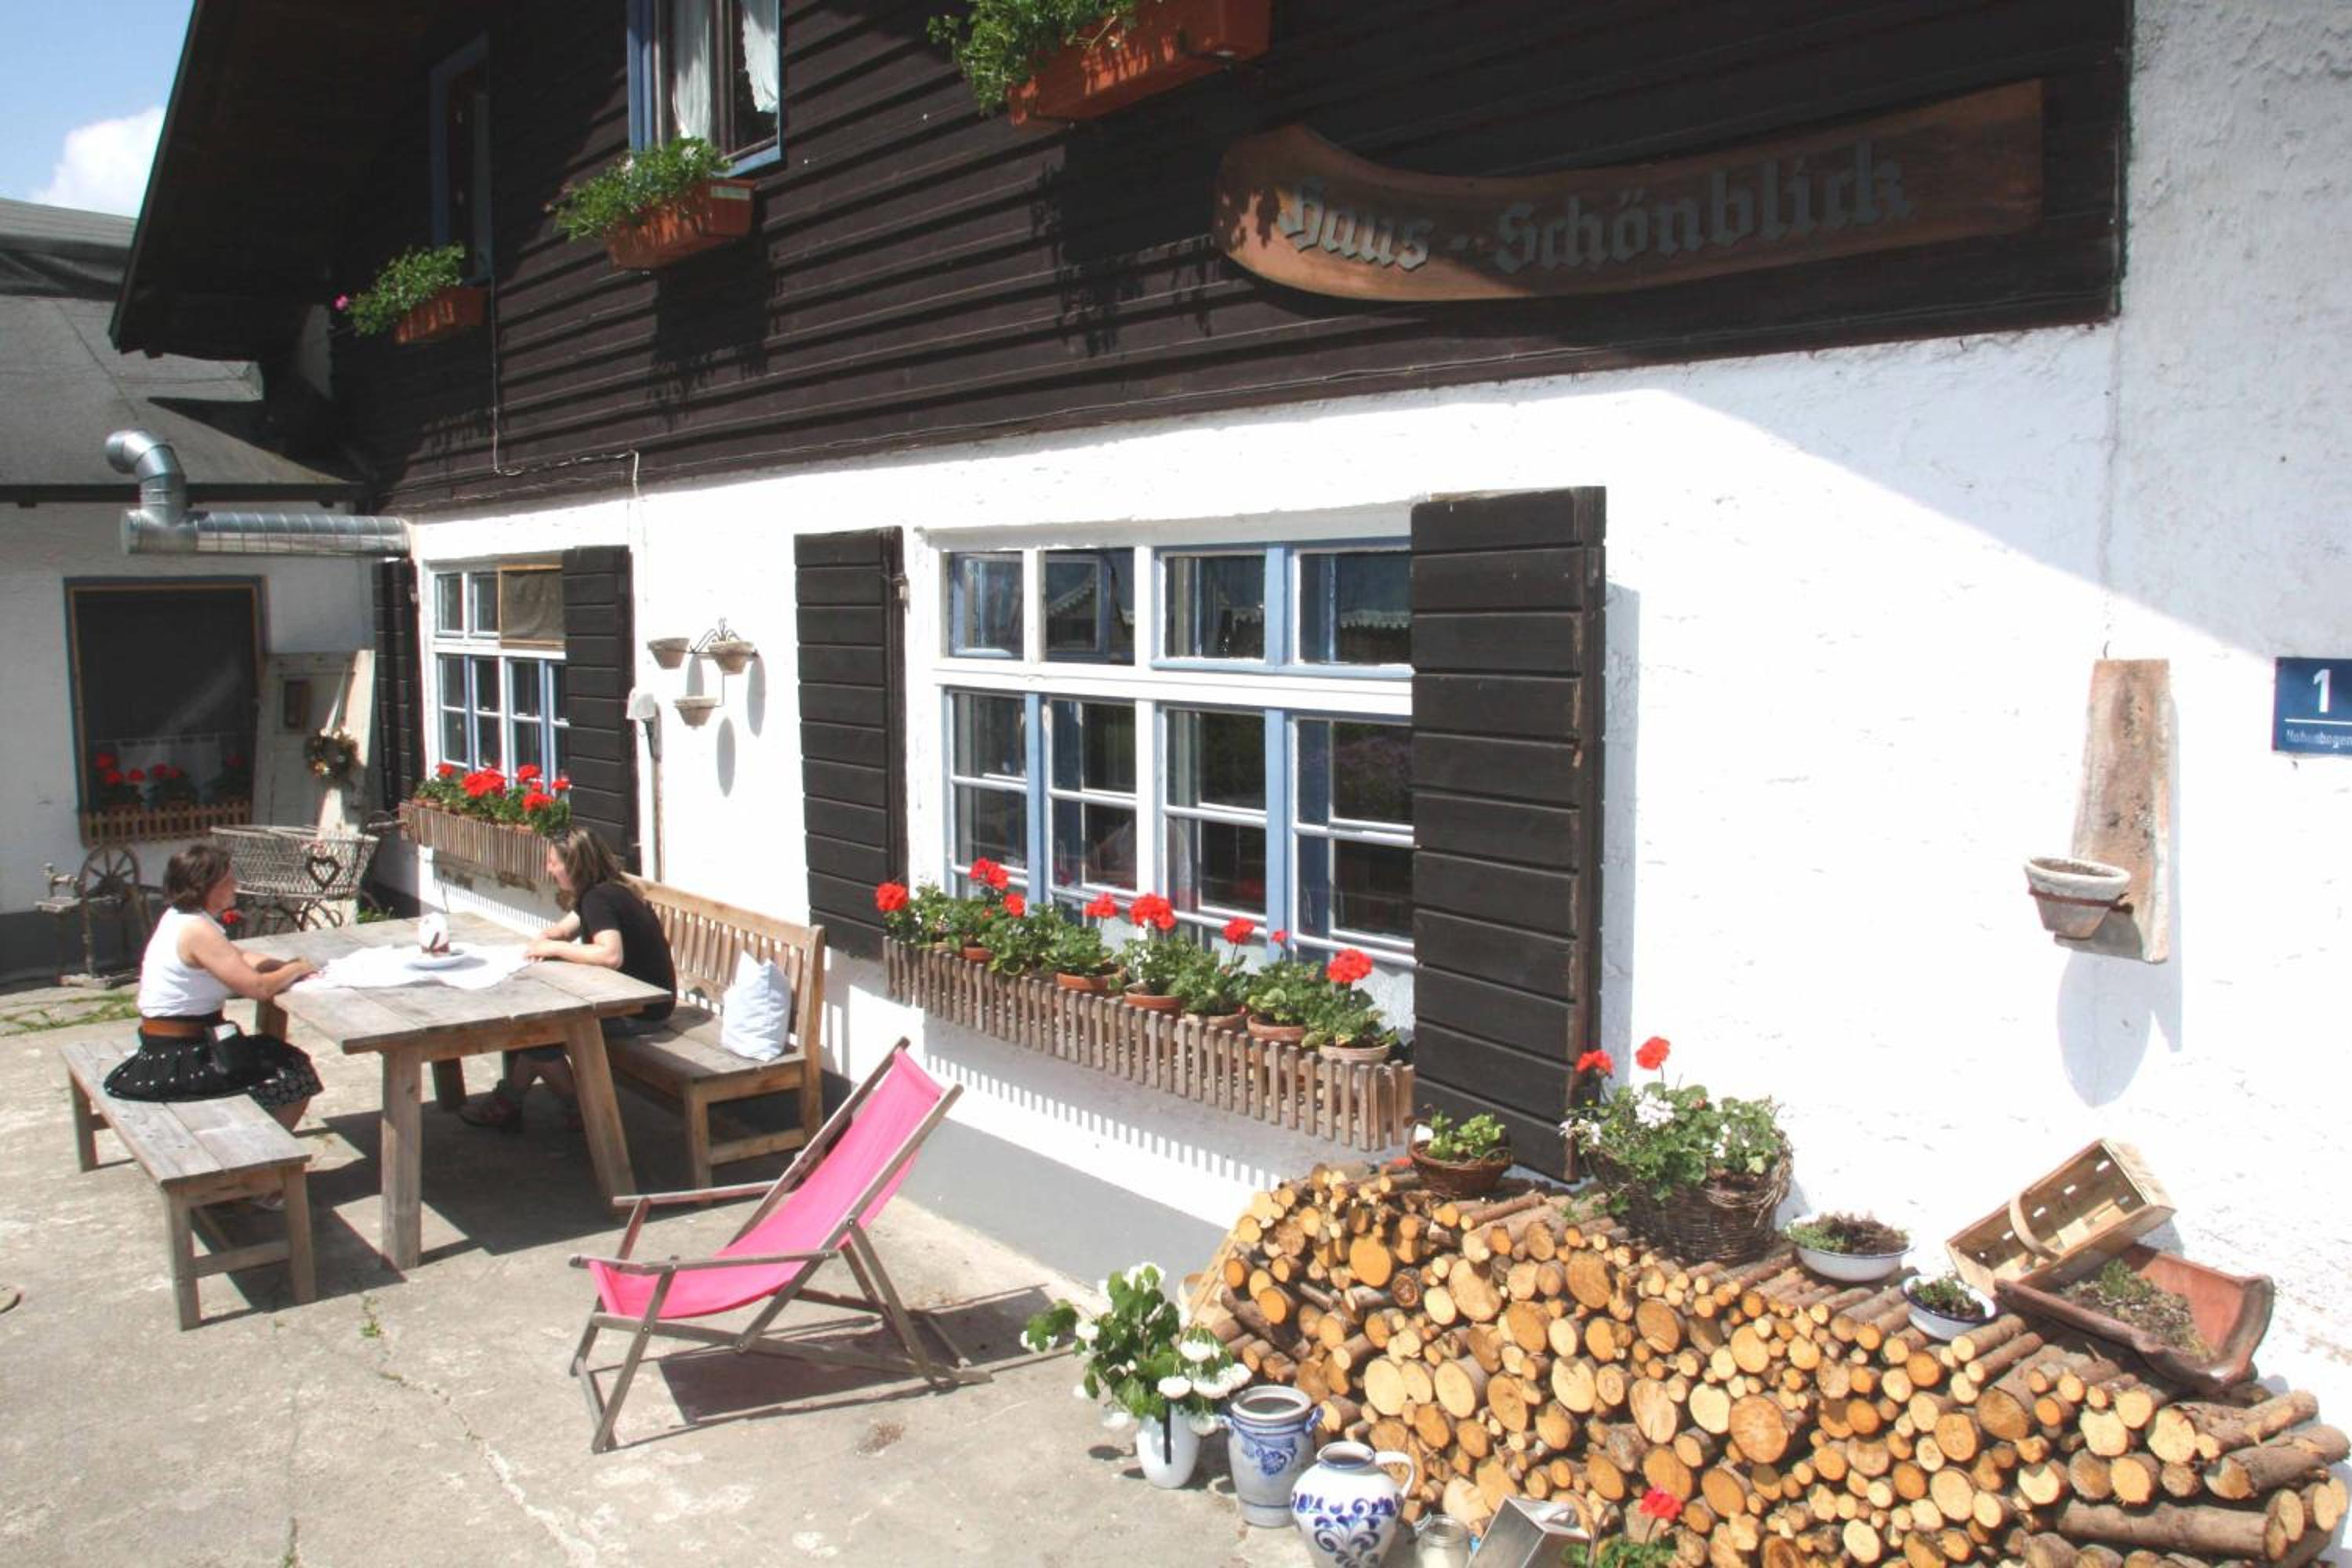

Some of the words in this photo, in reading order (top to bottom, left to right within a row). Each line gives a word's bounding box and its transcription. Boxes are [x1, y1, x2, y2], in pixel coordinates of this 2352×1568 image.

[1278, 177, 1432, 271] Haus
[1493, 140, 1911, 273] Schönblick
[2314, 669, 2331, 713] 1
